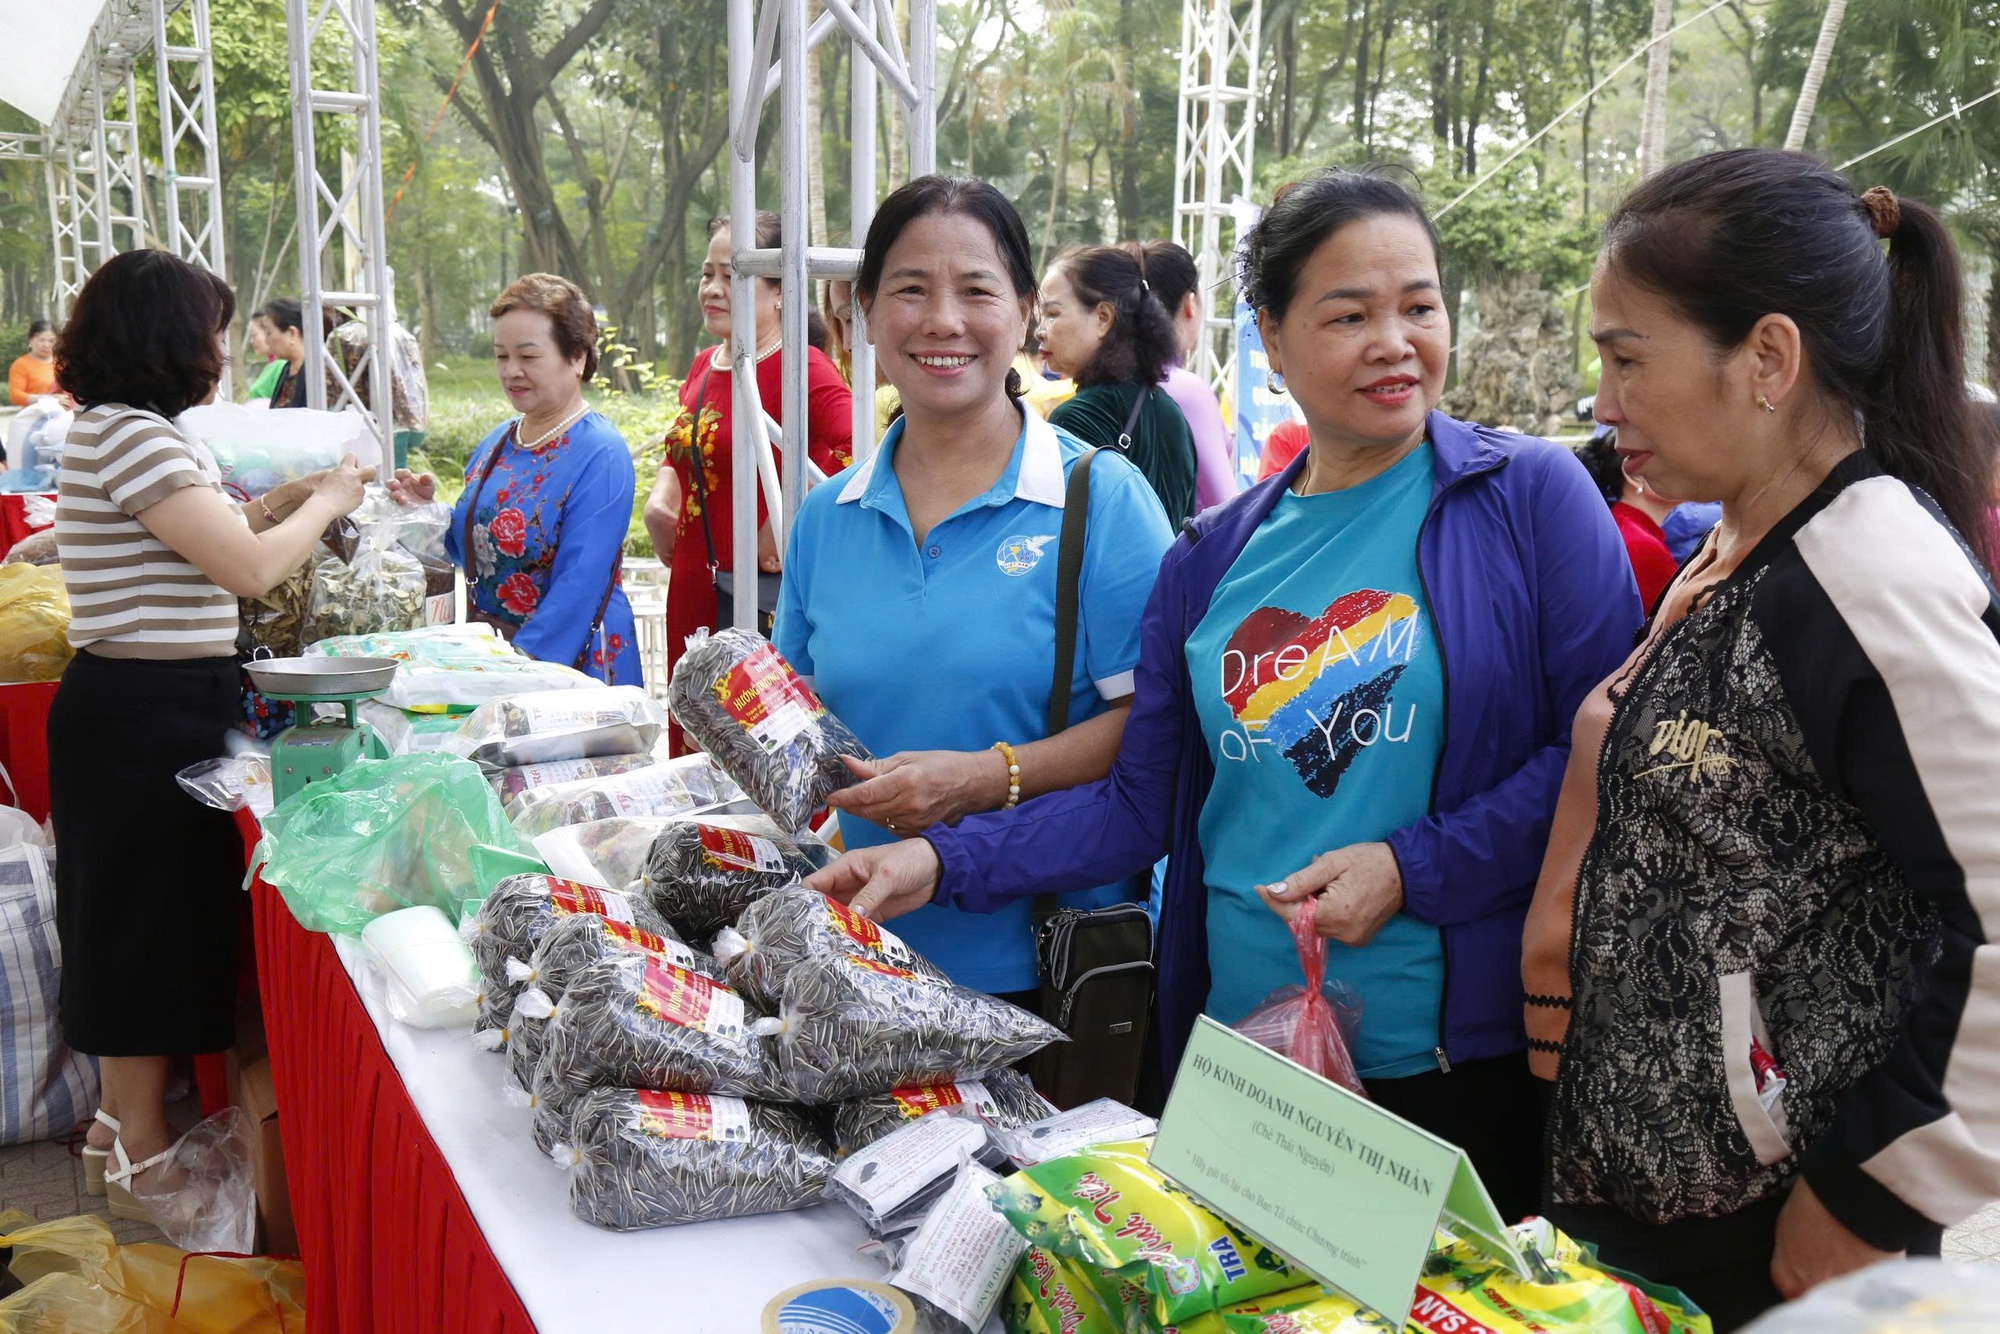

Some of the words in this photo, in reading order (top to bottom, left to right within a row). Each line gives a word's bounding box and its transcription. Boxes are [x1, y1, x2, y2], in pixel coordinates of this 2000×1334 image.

[1192, 1053, 1212, 1077] HỘ
[1213, 1065, 1246, 1093] KINH
[1246, 1083, 1294, 1120] DOANH
[1295, 1109, 1355, 1153] NGUYỄN
[1358, 1143, 1385, 1174] THỊ
[1275, 1131, 1295, 1153] Thái
[1256, 1194, 1273, 1213] Ban
[1208, 1236, 1247, 1284] TRÀ
[1413, 1295, 1467, 1332] SẢN
